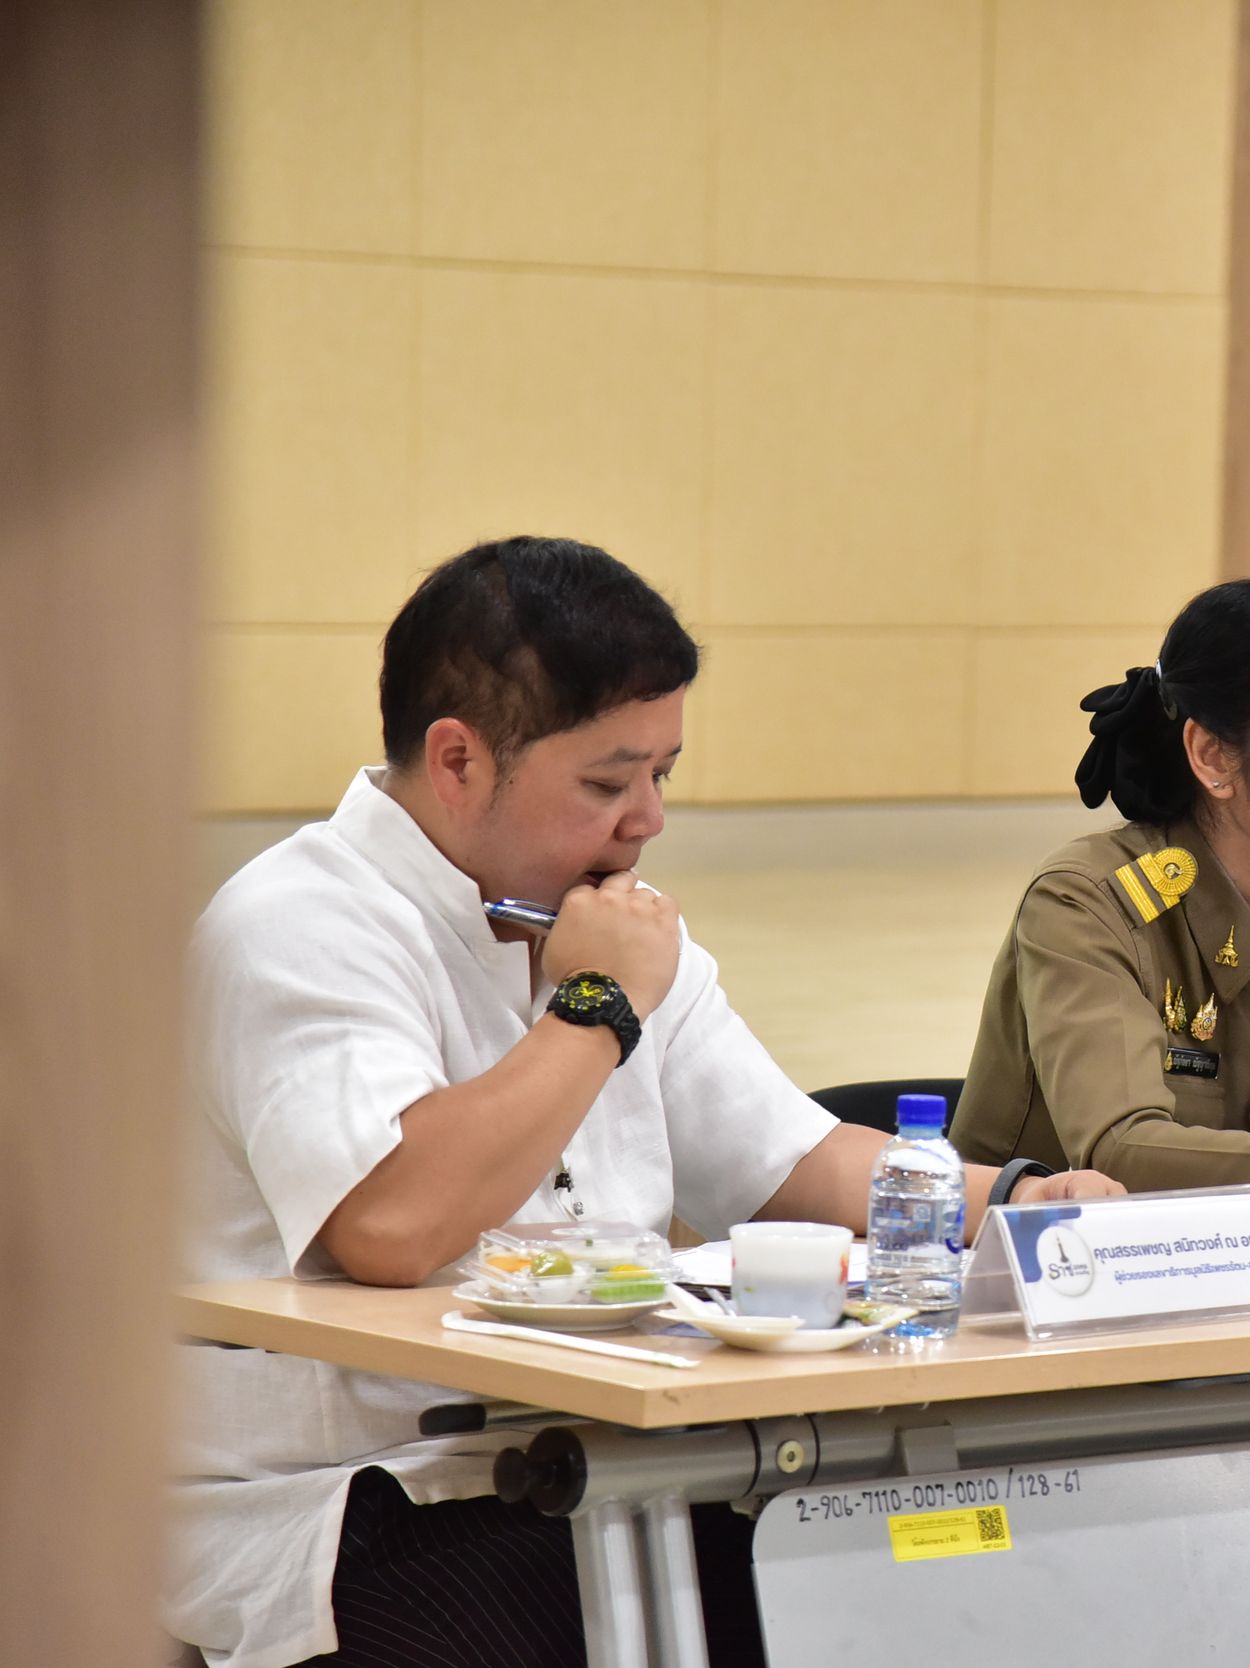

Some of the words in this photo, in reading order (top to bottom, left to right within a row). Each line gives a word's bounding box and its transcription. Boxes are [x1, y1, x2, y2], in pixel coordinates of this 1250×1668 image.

[1094, 1242, 1172, 1264] คุณสรรเพชญ
[1173, 1232, 1223, 1253] สนิทวงศ์
[1225, 1236, 1239, 1248] ณ
